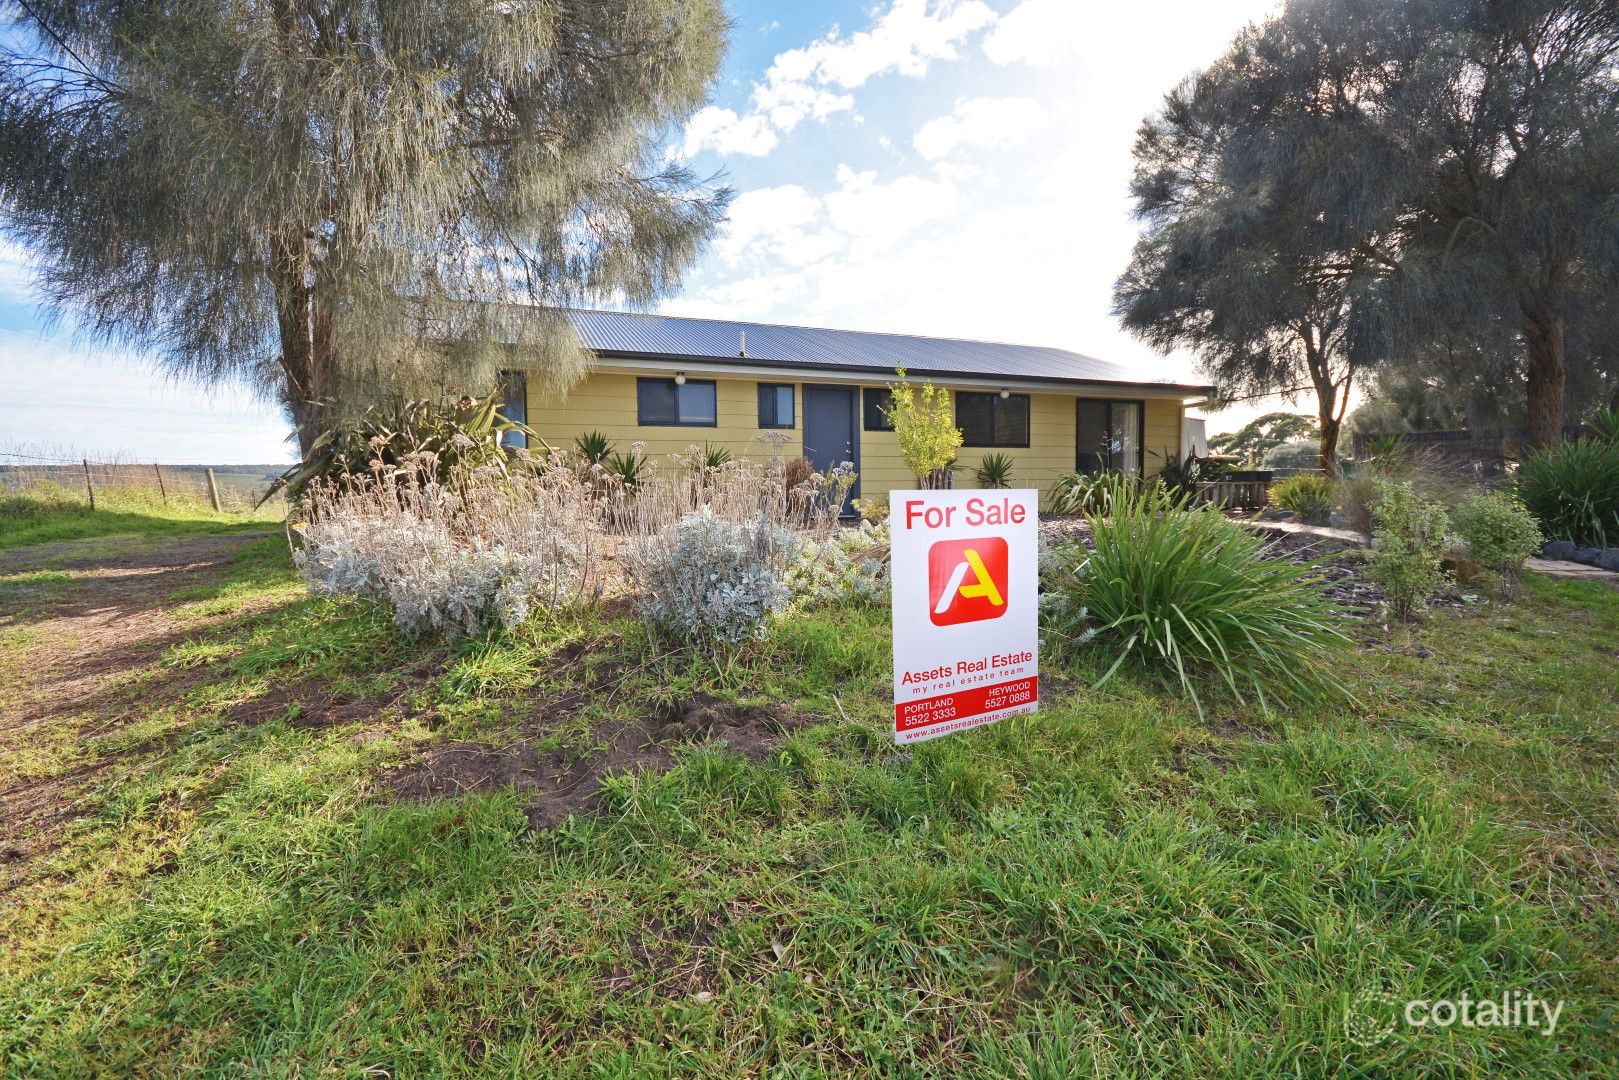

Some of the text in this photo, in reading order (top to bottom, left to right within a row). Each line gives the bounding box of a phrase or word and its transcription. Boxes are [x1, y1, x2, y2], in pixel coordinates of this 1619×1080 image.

[905, 497, 1026, 530] For Sale
[901, 651, 1033, 685] Assets Real Estate
[912, 667, 1024, 694] my real estate team
[989, 681, 1031, 697] HEYWOOD
[904, 697, 954, 714] PORTLAND
[984, 690, 1031, 709] 5527 0888
[905, 707, 956, 726] 5522 3333
[905, 706, 1031, 739] www.assetsrealestate.com.au
